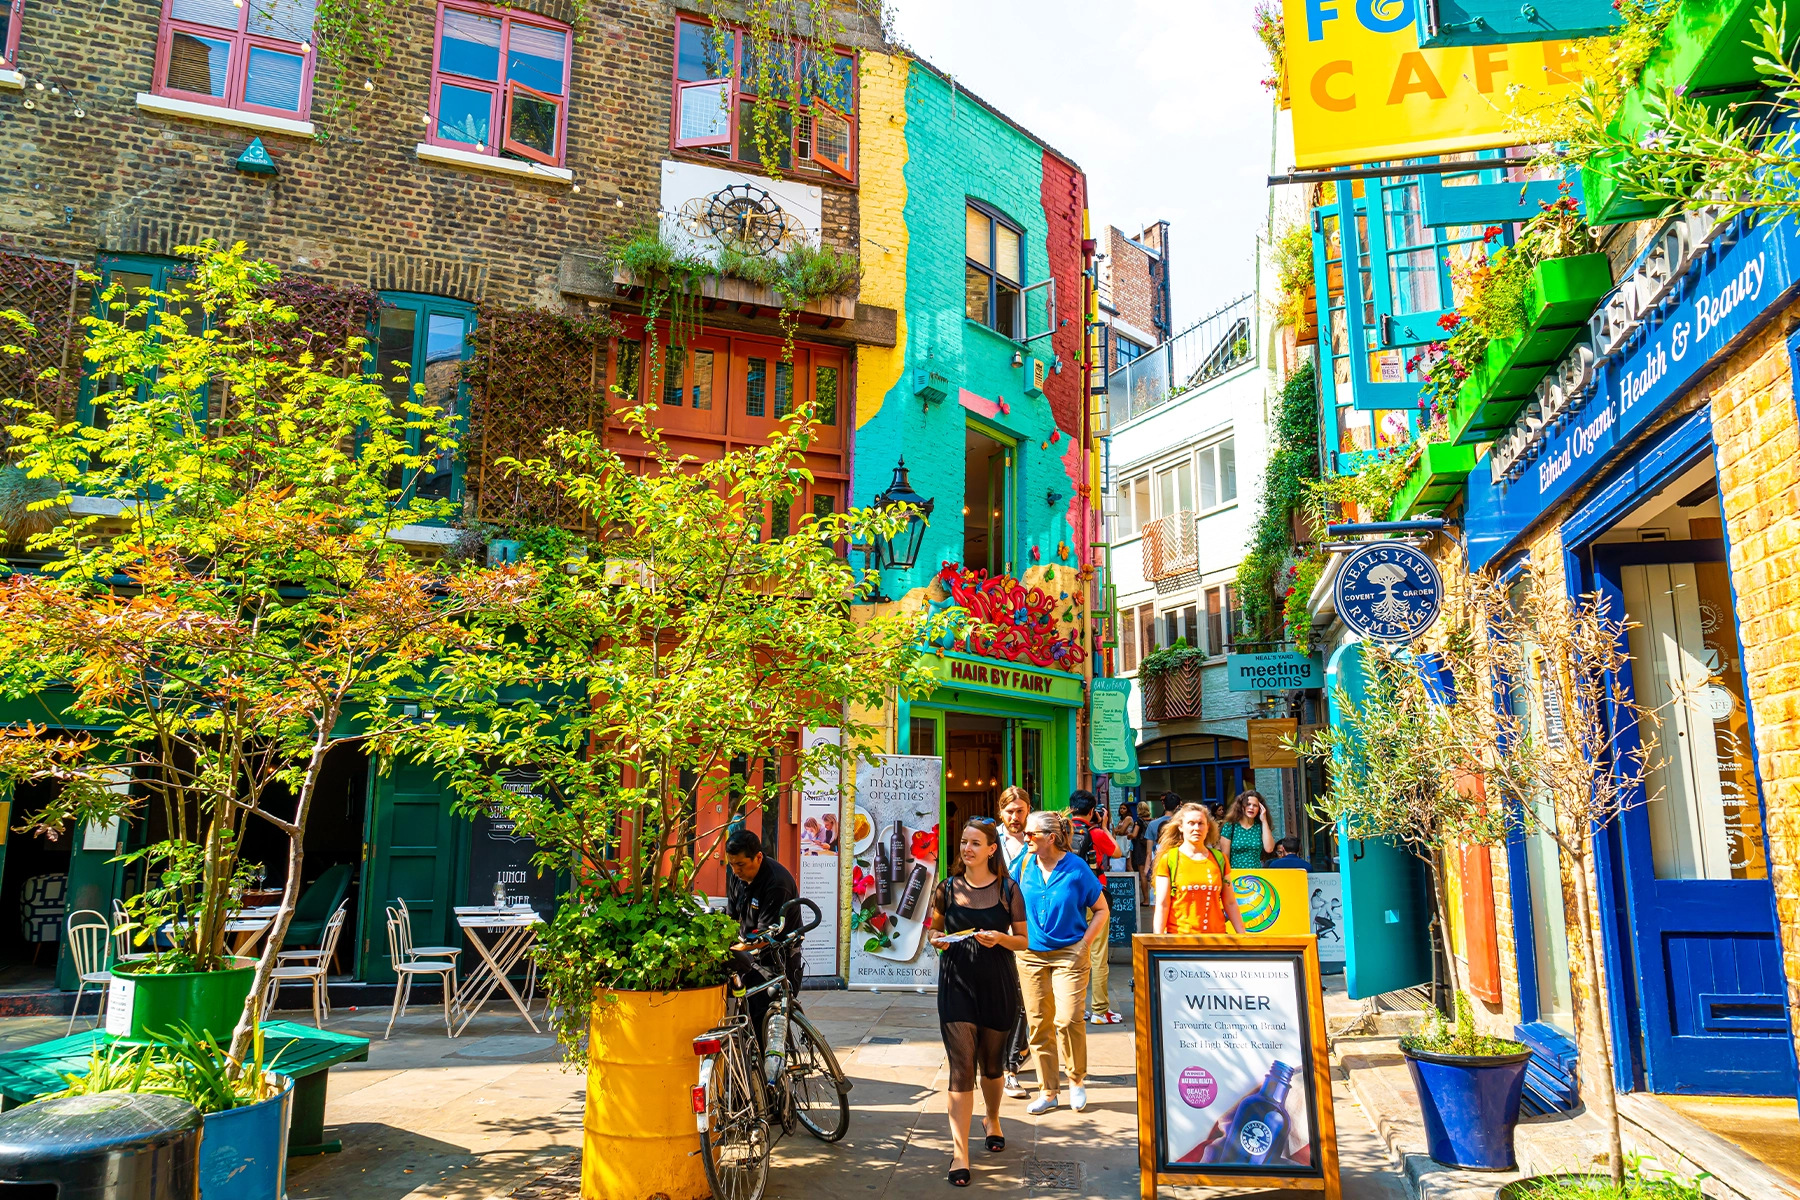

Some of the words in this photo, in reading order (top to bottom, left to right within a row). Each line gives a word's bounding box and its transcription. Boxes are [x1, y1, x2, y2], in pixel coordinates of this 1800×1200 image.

[1309, 38, 1584, 112] CAFE
[243, 155, 268, 165] Chubb
[1538, 436, 1572, 494] Ethical
[1572, 395, 1617, 458] Organic
[1619, 341, 1667, 415] Health
[1671, 321, 1691, 362] &
[1694, 251, 1766, 343] Beauty
[1344, 550, 1389, 591] NEAL'S
[1394, 551, 1432, 585] YARD
[1344, 593, 1375, 602] COVENT
[1402, 588, 1434, 597] GARDEN
[1240, 661, 1311, 678] meeting
[951, 661, 989, 683] HAIR
[990, 667, 1011, 687] BY
[1012, 671, 1053, 693] FAIRY
[1250, 675, 1302, 688] rooms
[880, 764, 914, 779] john
[869, 778, 926, 790] masters
[869, 791, 925, 804] organics
[812, 860, 836, 868] inspired
[497, 871, 527, 883] LUNCH
[858, 967, 886, 976] REPAIR
[888, 968, 894, 976] &
[896, 968, 932, 976] RESTORE
[1180, 970, 1211, 979] NEAL'S
[1212, 970, 1238, 979] YARD
[1240, 970, 1290, 979] REMEDIES
[1185, 995, 1271, 1010] WINNER
[1173, 1021, 1212, 1030] Favourite
[1214, 1021, 1258, 1032] Champion
[1260, 1021, 1287, 1030] Brand
[1222, 1031, 1238, 1040] and
[1179, 1040, 1198, 1049] Best
[1200, 1040, 1221, 1050] High
[1223, 1040, 1248, 1049] Street
[1250, 1041, 1284, 1050] Retailer
